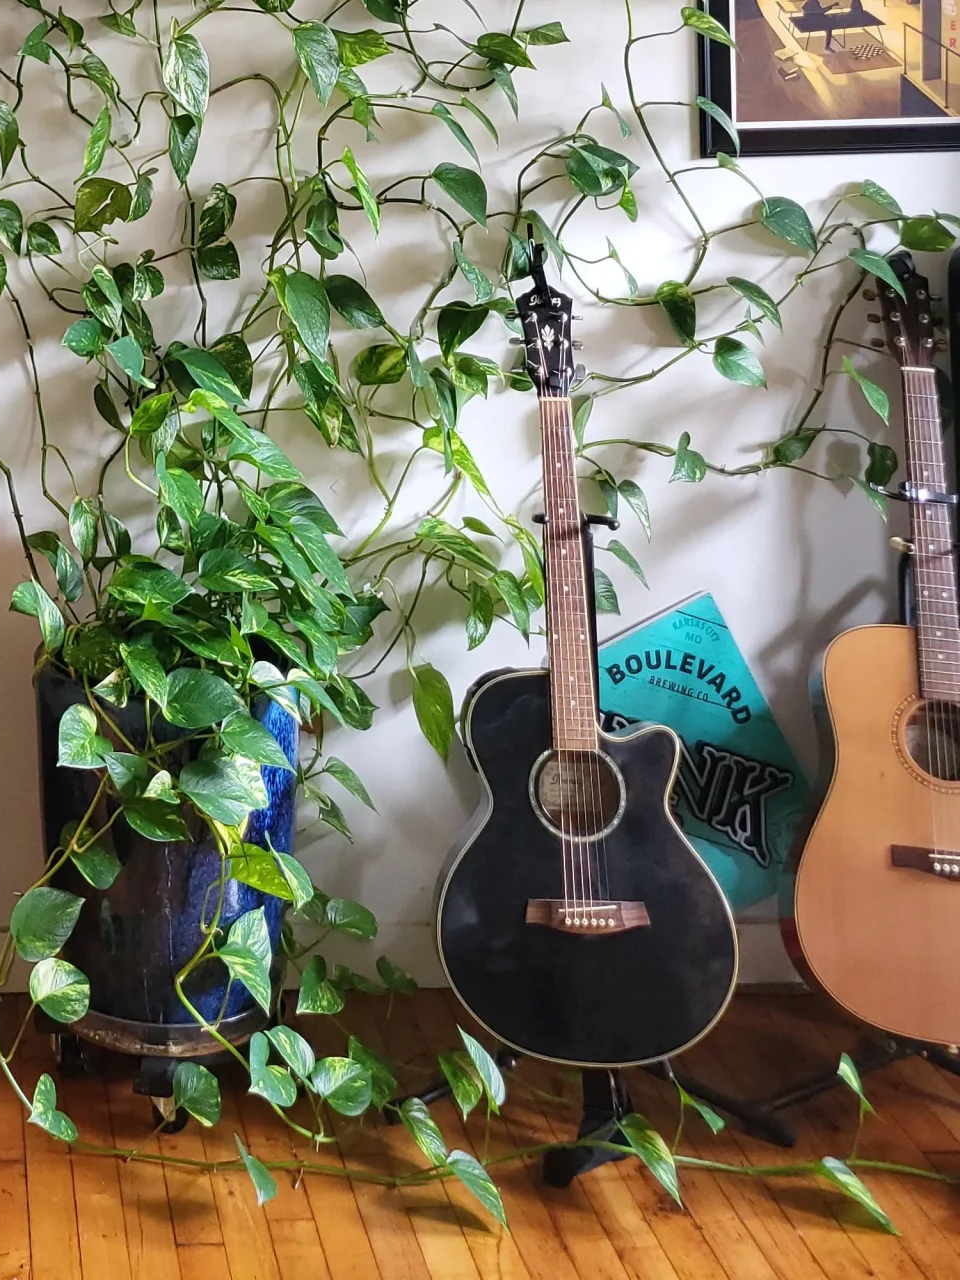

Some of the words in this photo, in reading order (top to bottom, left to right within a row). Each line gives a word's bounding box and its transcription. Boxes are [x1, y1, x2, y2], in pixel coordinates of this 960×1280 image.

[672, 616, 705, 632] KANSAS
[705, 625, 721, 643] CITY
[685, 631, 702, 644] MO
[606, 649, 752, 725] BOULEVARD
[649, 674, 695, 697] BREWING
